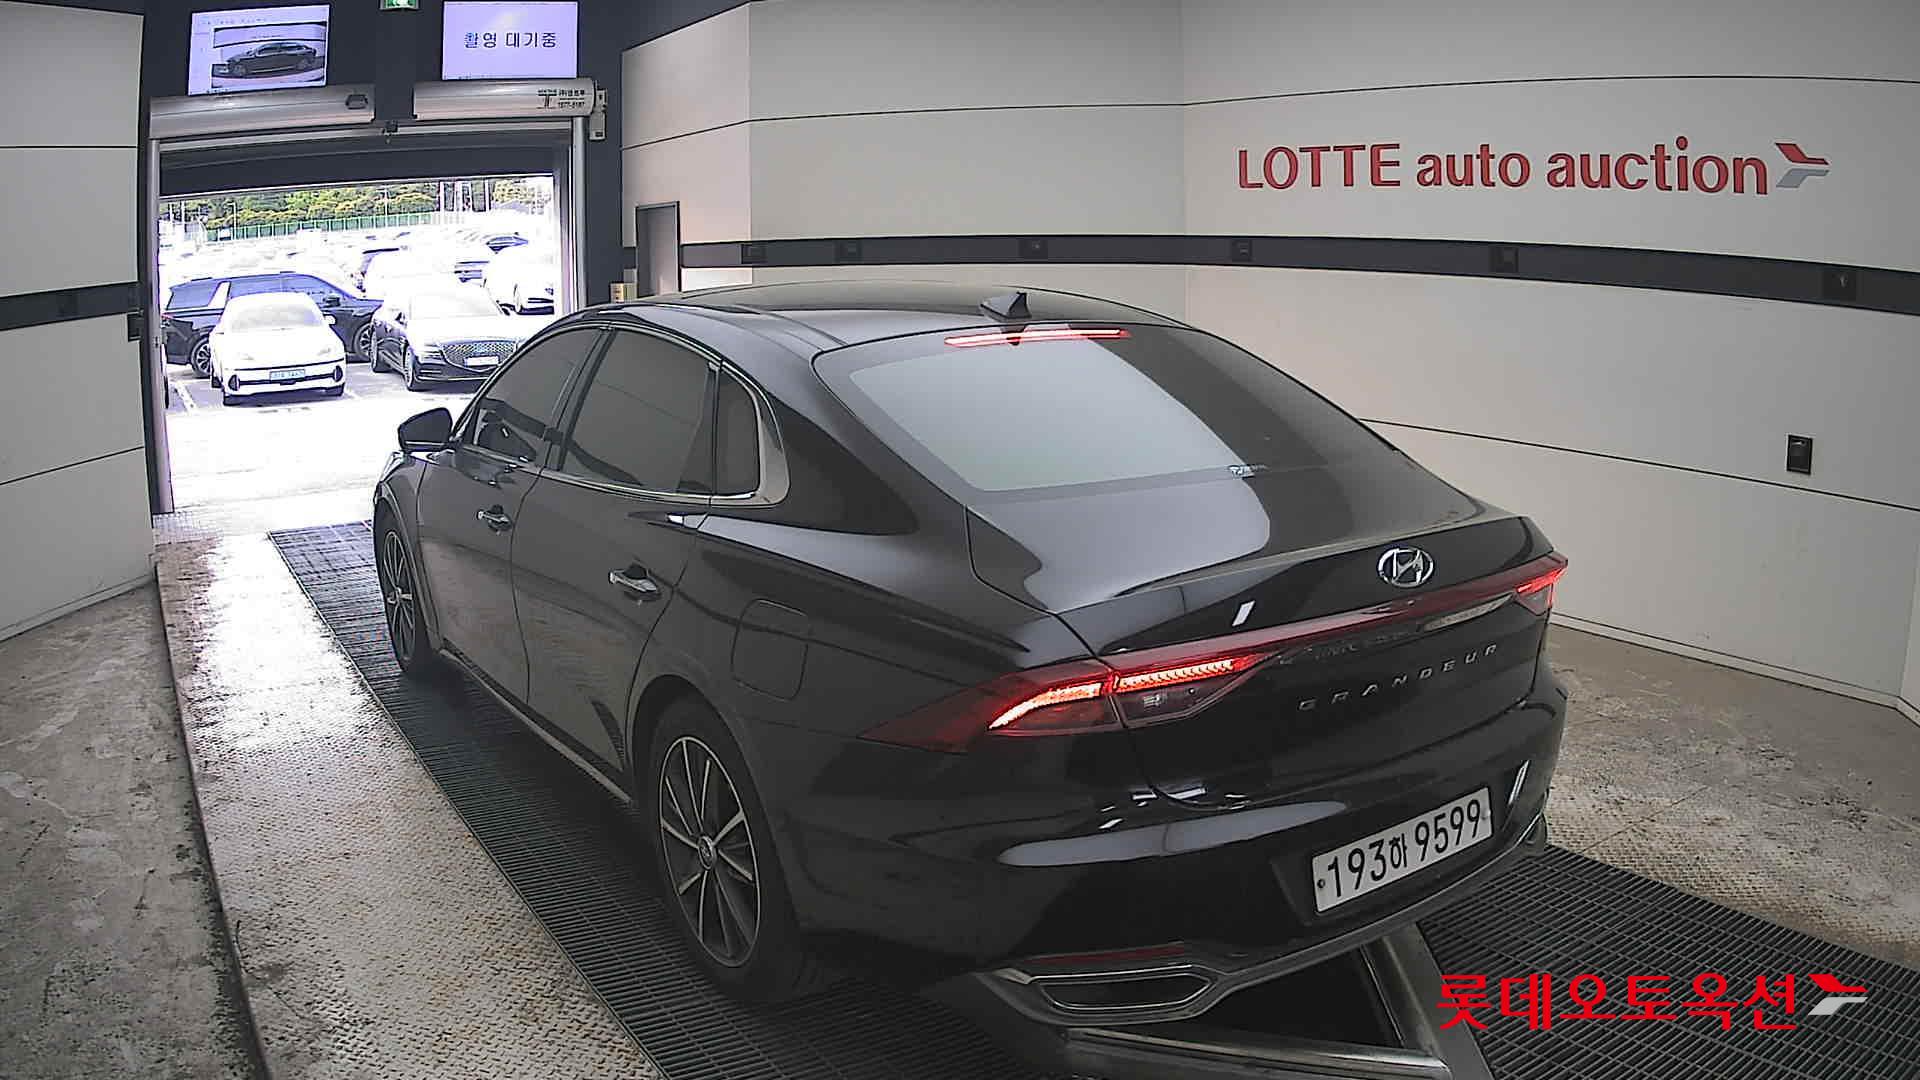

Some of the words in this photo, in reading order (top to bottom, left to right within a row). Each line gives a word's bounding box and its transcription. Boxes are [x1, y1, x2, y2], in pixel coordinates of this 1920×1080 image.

[505, 32, 556, 48] 대기중
[1238, 144, 1400, 189] LOTTE
[1416, 144, 1530, 187] auto
[1546, 135, 1768, 195] auction
[1298, 644, 1497, 711] GRANDEUR
[1327, 833, 1407, 898] 193하
[1414, 799, 1481, 862] 9599
